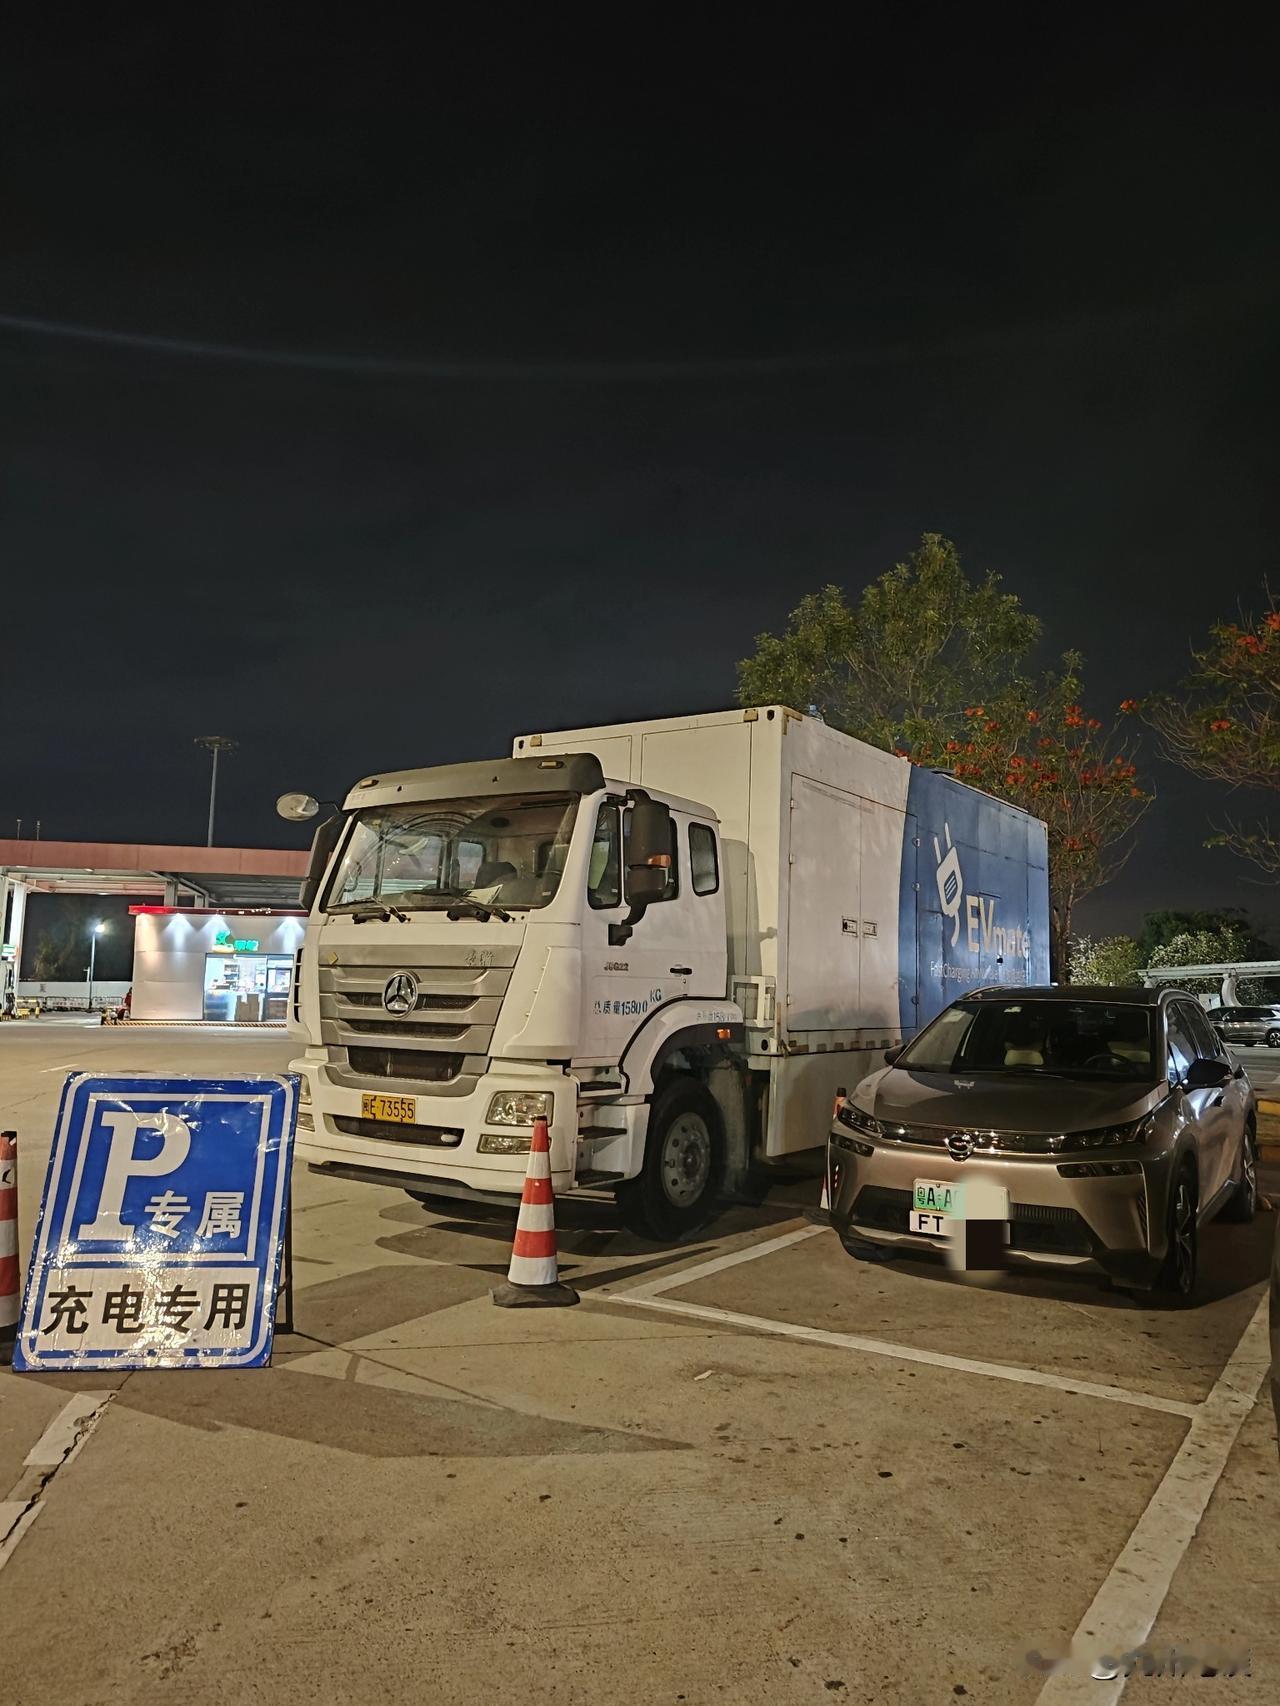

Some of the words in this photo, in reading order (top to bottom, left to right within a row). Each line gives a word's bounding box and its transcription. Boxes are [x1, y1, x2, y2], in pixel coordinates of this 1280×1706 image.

[966, 895, 1031, 958] EVmate
[77, 1111, 191, 1241] P
[144, 1190, 245, 1239] 专属
[42, 1283, 250, 1335] 充电专用
